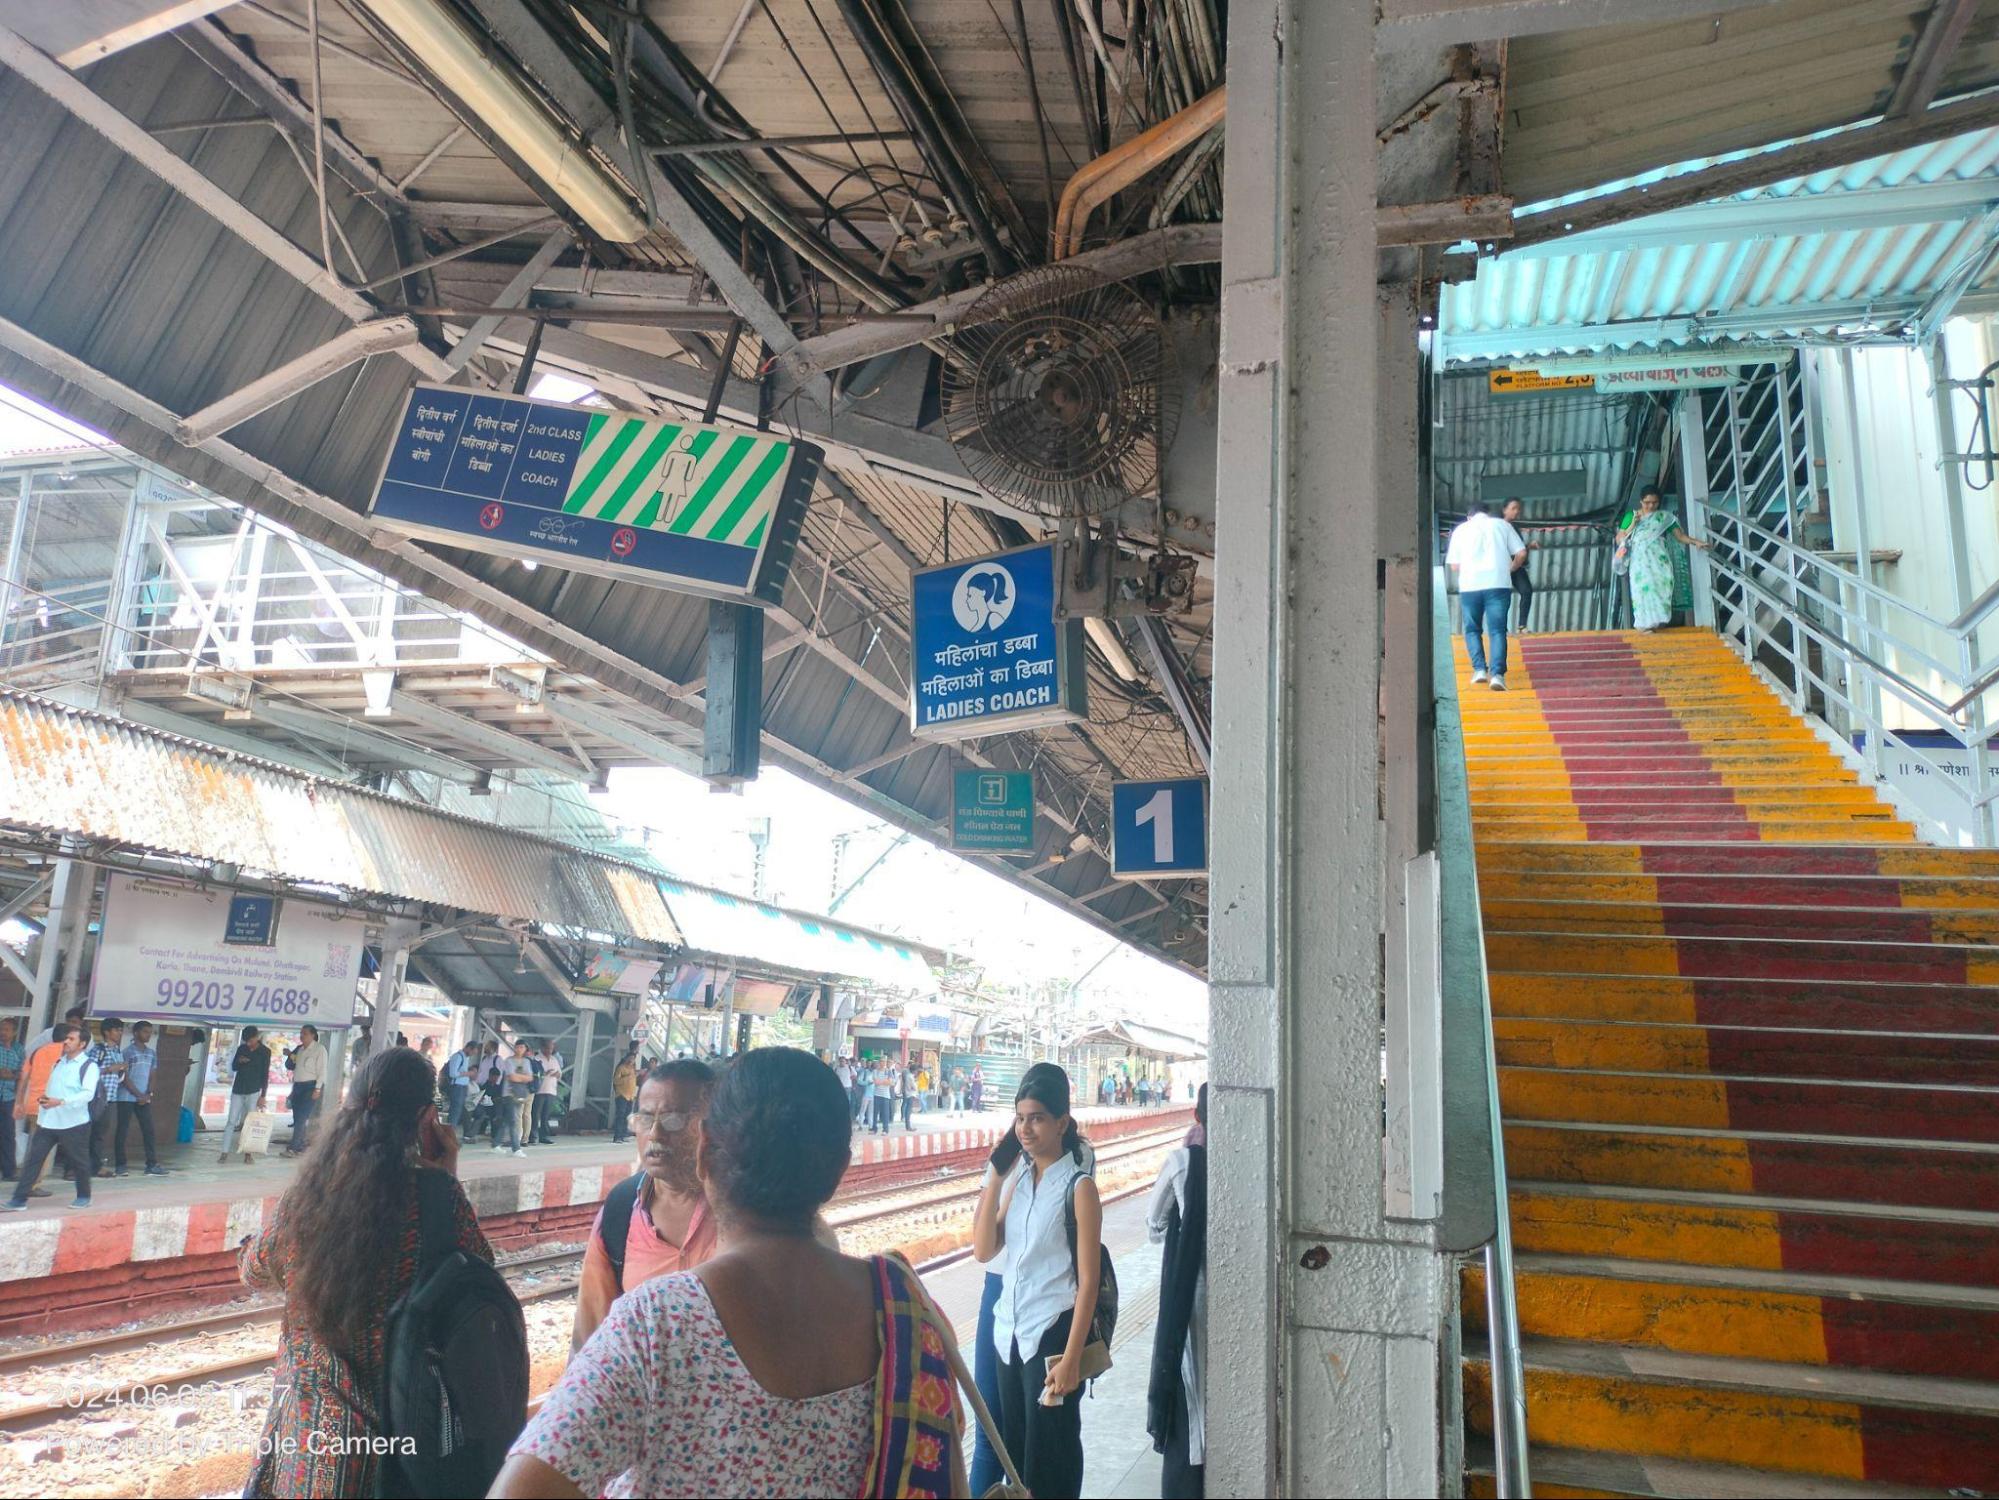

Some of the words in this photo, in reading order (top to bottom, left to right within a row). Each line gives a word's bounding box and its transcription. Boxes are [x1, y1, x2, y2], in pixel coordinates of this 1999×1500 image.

[528, 424, 545, 436] 2nd
[548, 426, 582, 441] CLASS
[500, 443, 515, 454] का
[528, 448, 566, 464] LADIES
[521, 472, 558, 487] COACH
[935, 640, 998, 667] महिलांचा
[1004, 634, 1038, 654] डब्बा
[922, 668, 984, 697] महिलाओं
[990, 667, 1009, 684] का
[1015, 659, 1053, 681] डिब्बा
[927, 698, 984, 722] LADIES
[990, 686, 1050, 711] COACH
[1136, 789, 1174, 863] 1
[140, 946, 170, 957] Contact
[244, 969, 272, 981] Railway
[274, 972, 298, 981] Station
[156, 978, 234, 1011] 99203
[243, 984, 311, 1015] 74688
